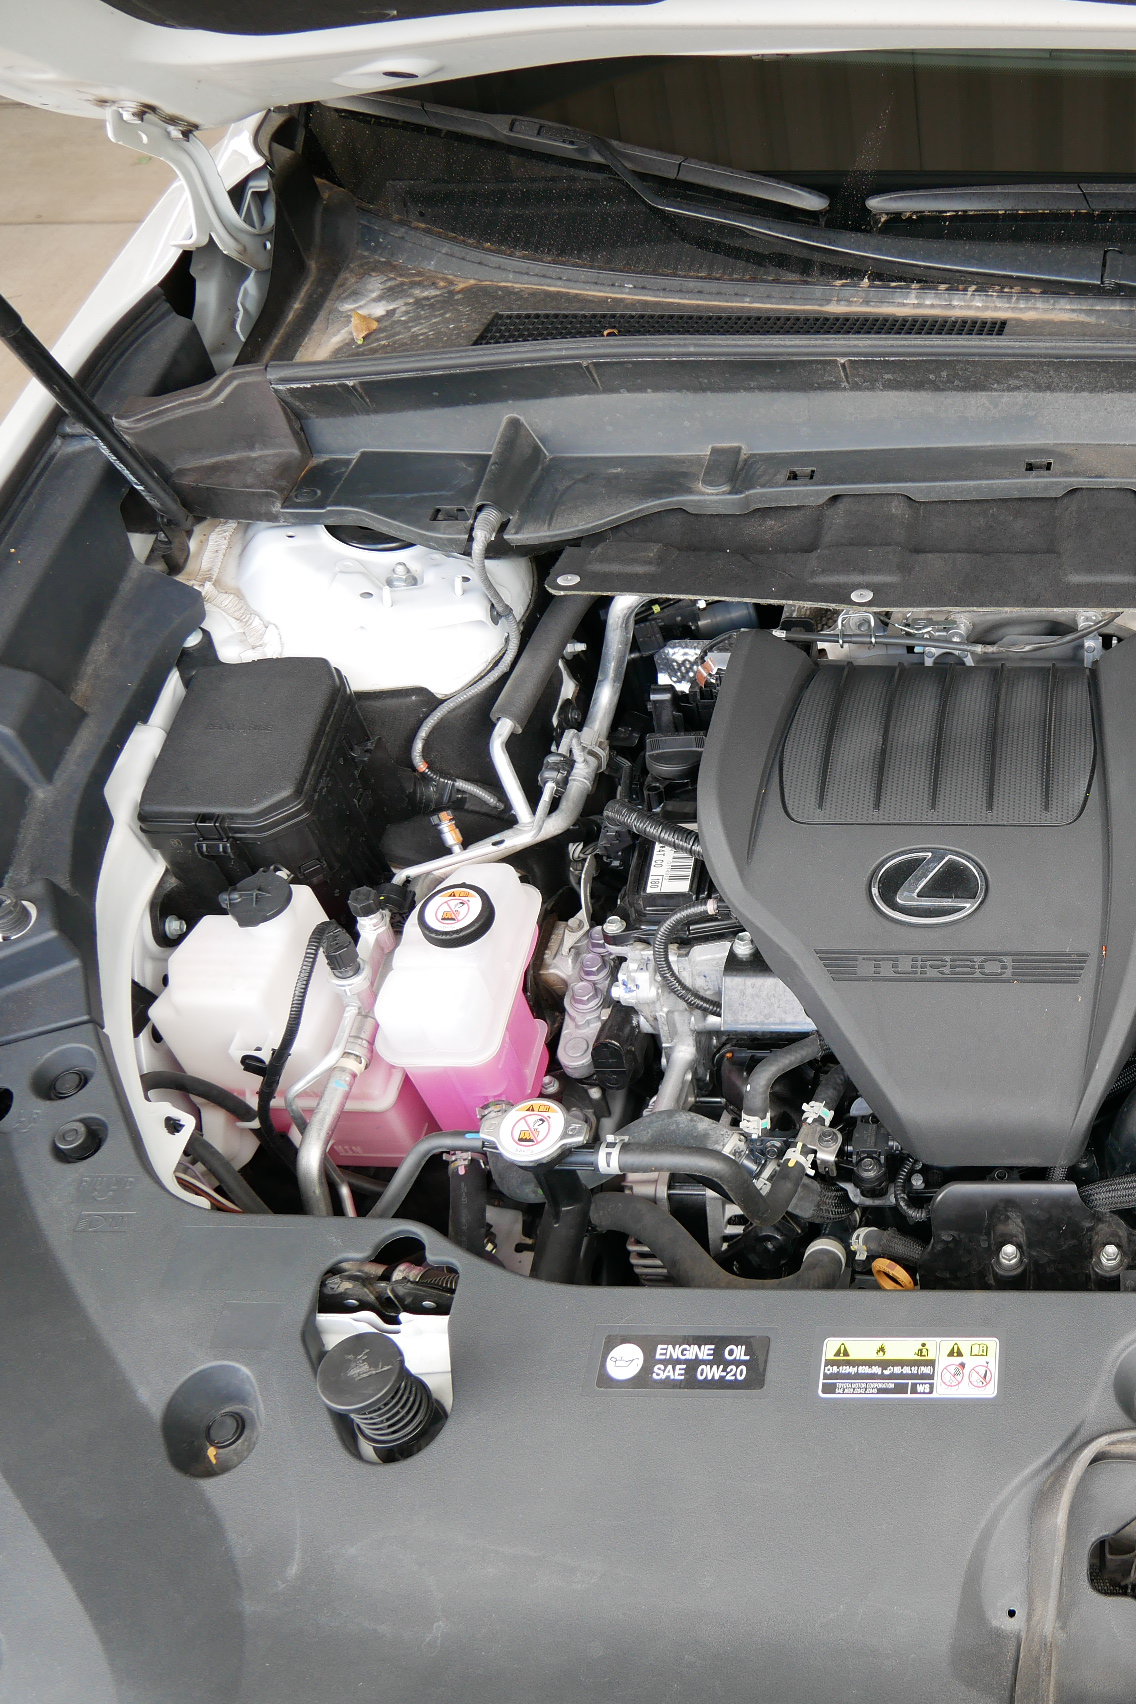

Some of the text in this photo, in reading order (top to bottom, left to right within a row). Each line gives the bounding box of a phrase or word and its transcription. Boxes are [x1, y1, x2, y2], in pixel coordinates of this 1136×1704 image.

[860, 955, 1010, 976] TURBO
[655, 1344, 751, 1361] ENGINE OIL
[652, 1364, 747, 1381] SAE 0W-20
[917, 1384, 930, 1393] WS
